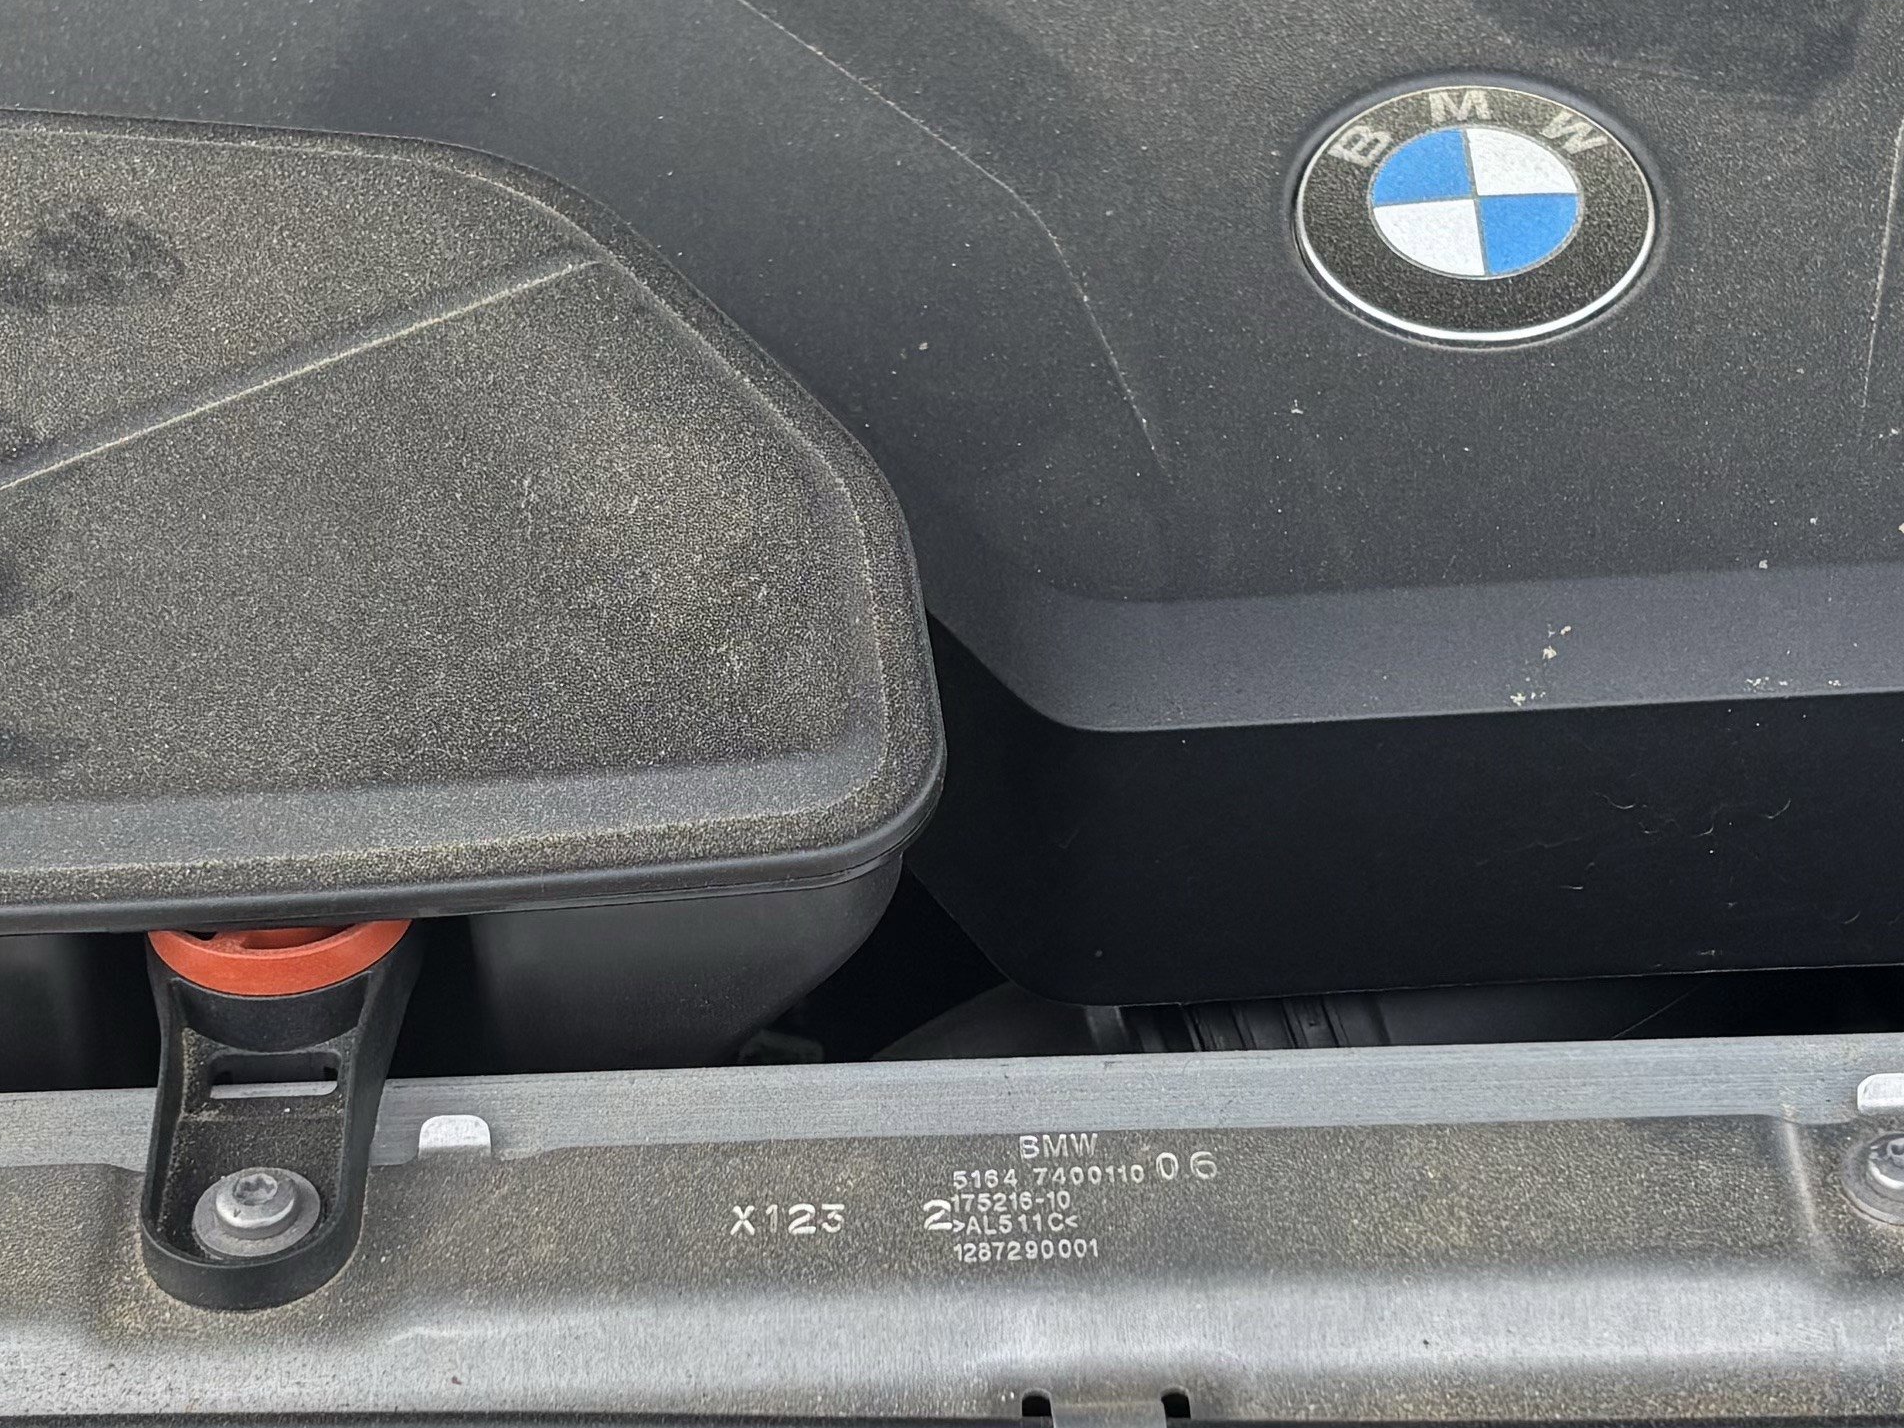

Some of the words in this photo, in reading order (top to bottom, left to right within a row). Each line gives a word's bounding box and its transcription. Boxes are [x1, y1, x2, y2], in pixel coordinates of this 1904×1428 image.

[1327, 88, 1609, 169] BMW
[1019, 1133, 1097, 1160] BMW
[953, 1168, 1018, 1190] 5164
[1033, 1164, 1145, 1186] 7400110
[951, 1190, 1071, 1213] 175216-10
[730, 1203, 845, 1236] X123
[953, 1238, 1098, 1263] 1287290001
